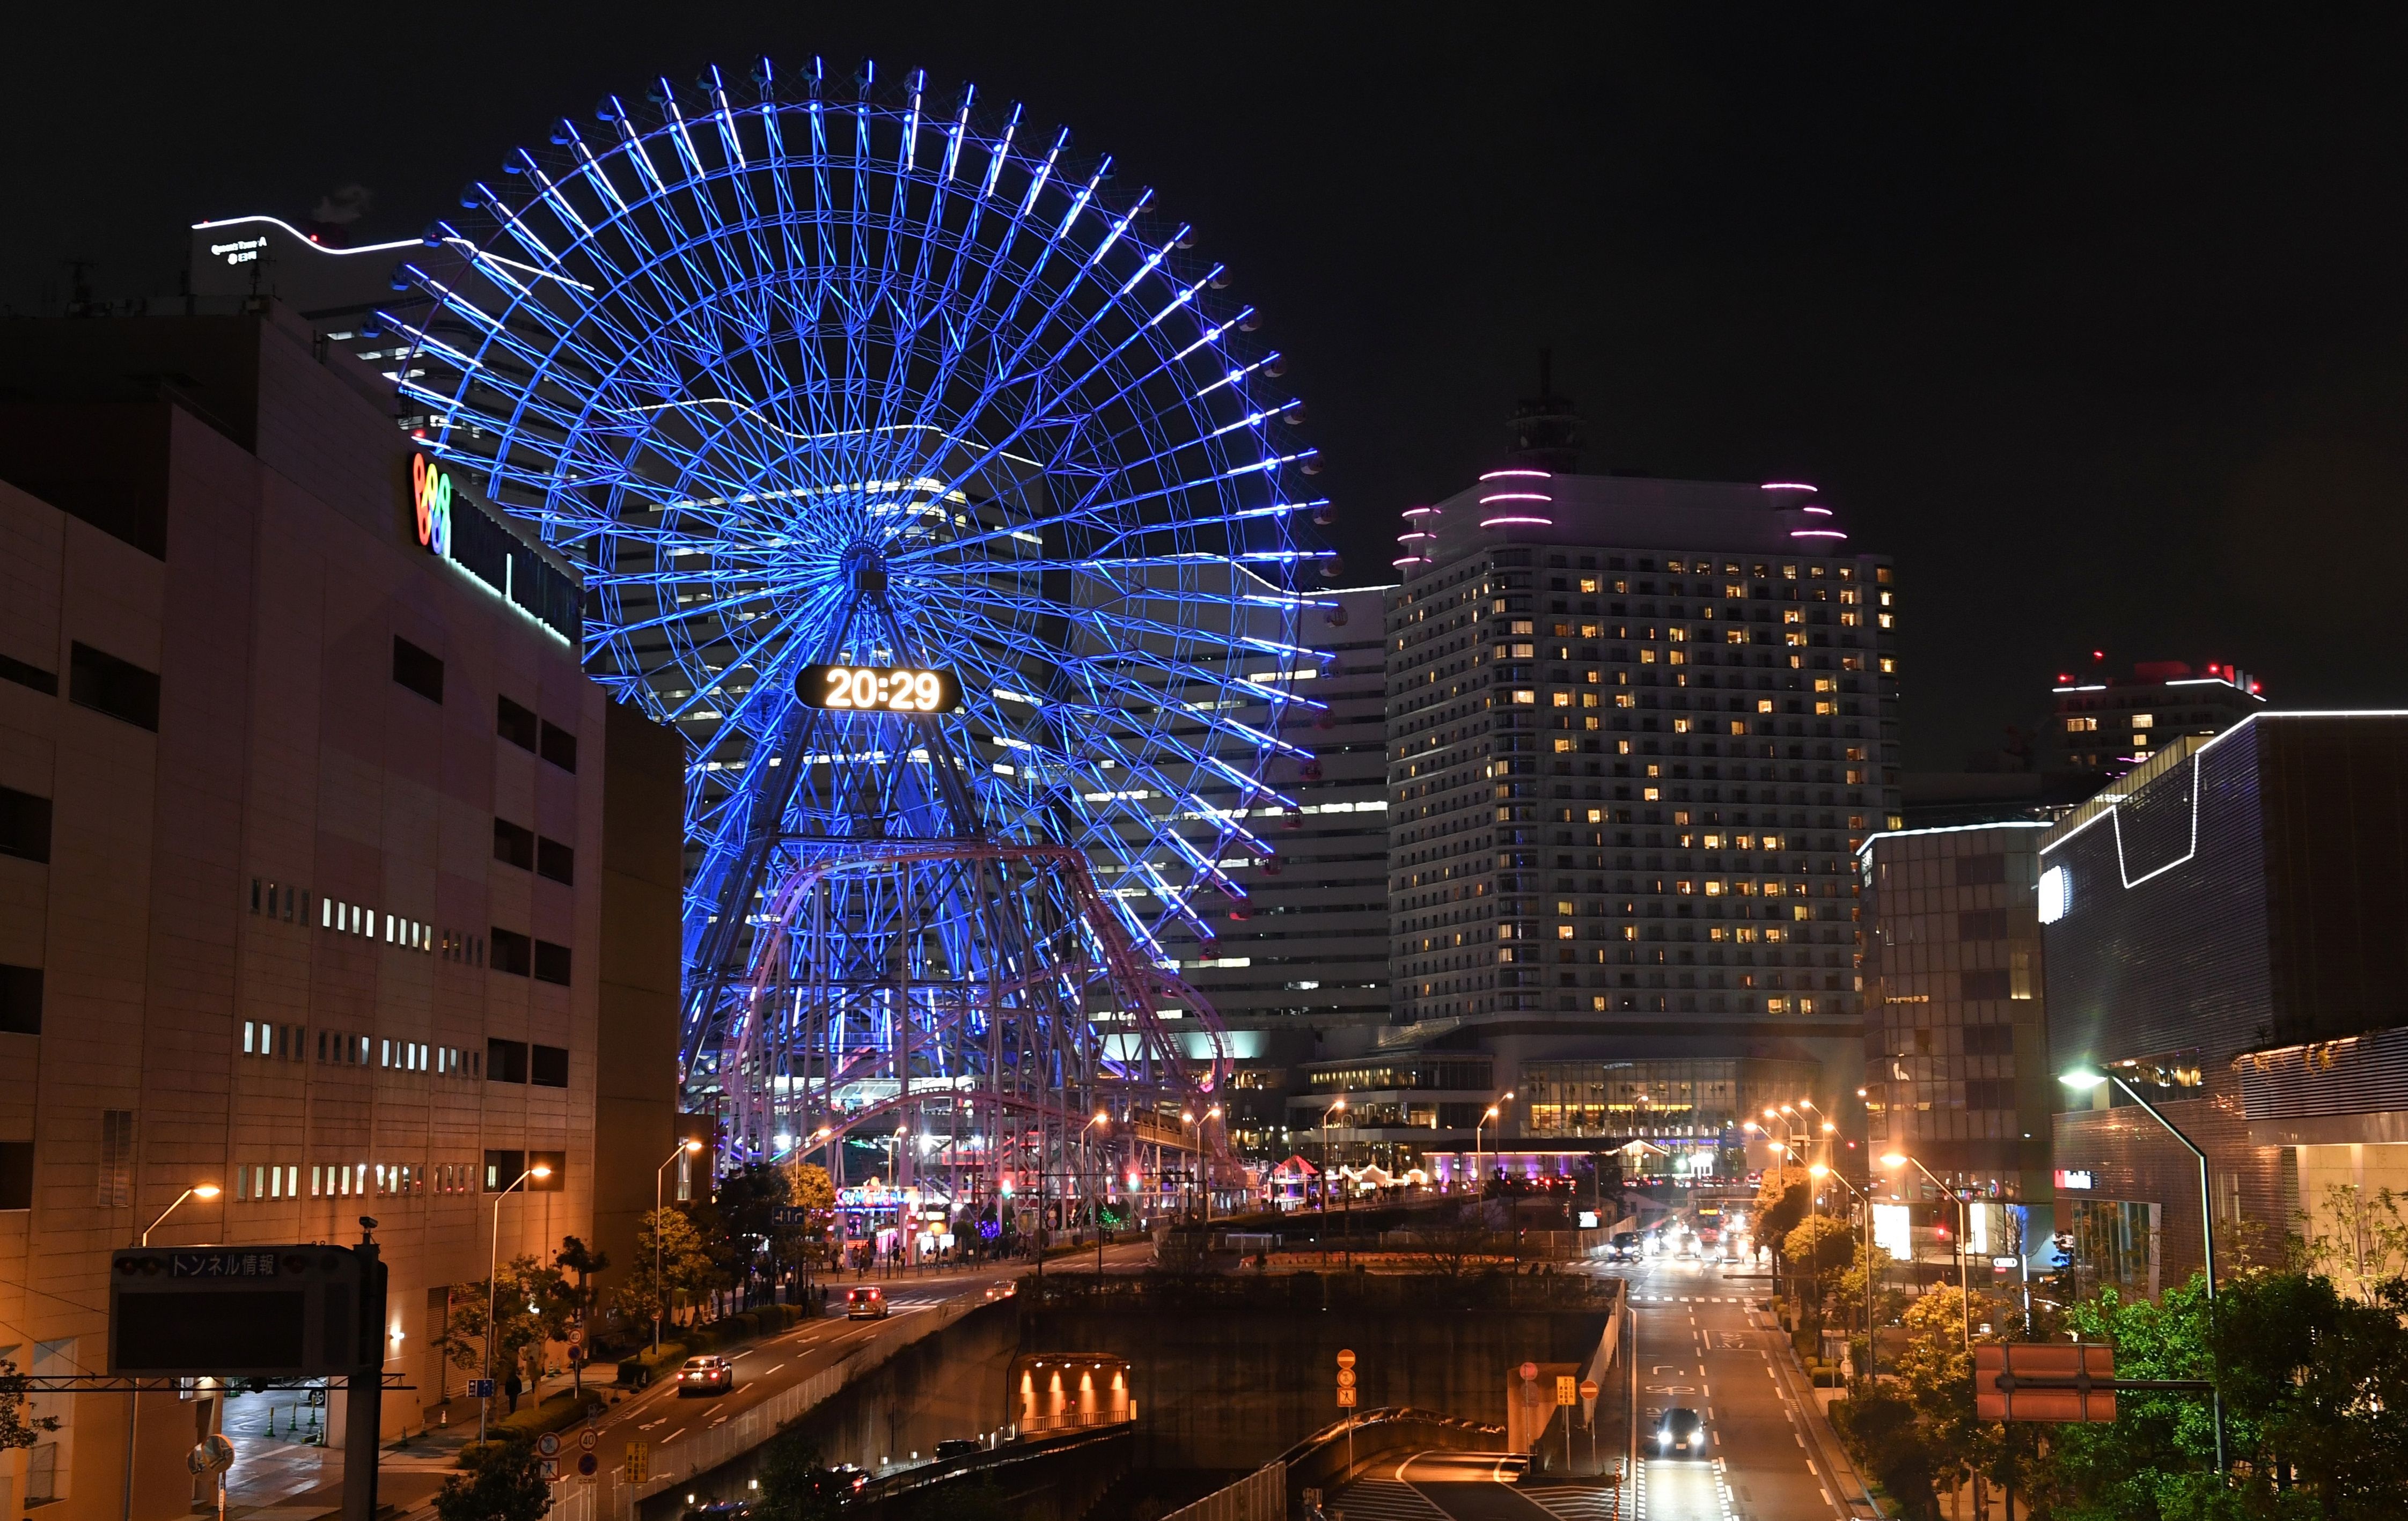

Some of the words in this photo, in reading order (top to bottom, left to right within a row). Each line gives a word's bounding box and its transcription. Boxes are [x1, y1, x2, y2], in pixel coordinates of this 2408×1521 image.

[825, 668, 940, 710] 20:29
[173, 1254, 274, 1276] トンネル情報
[583, 1435, 594, 1445] 40
